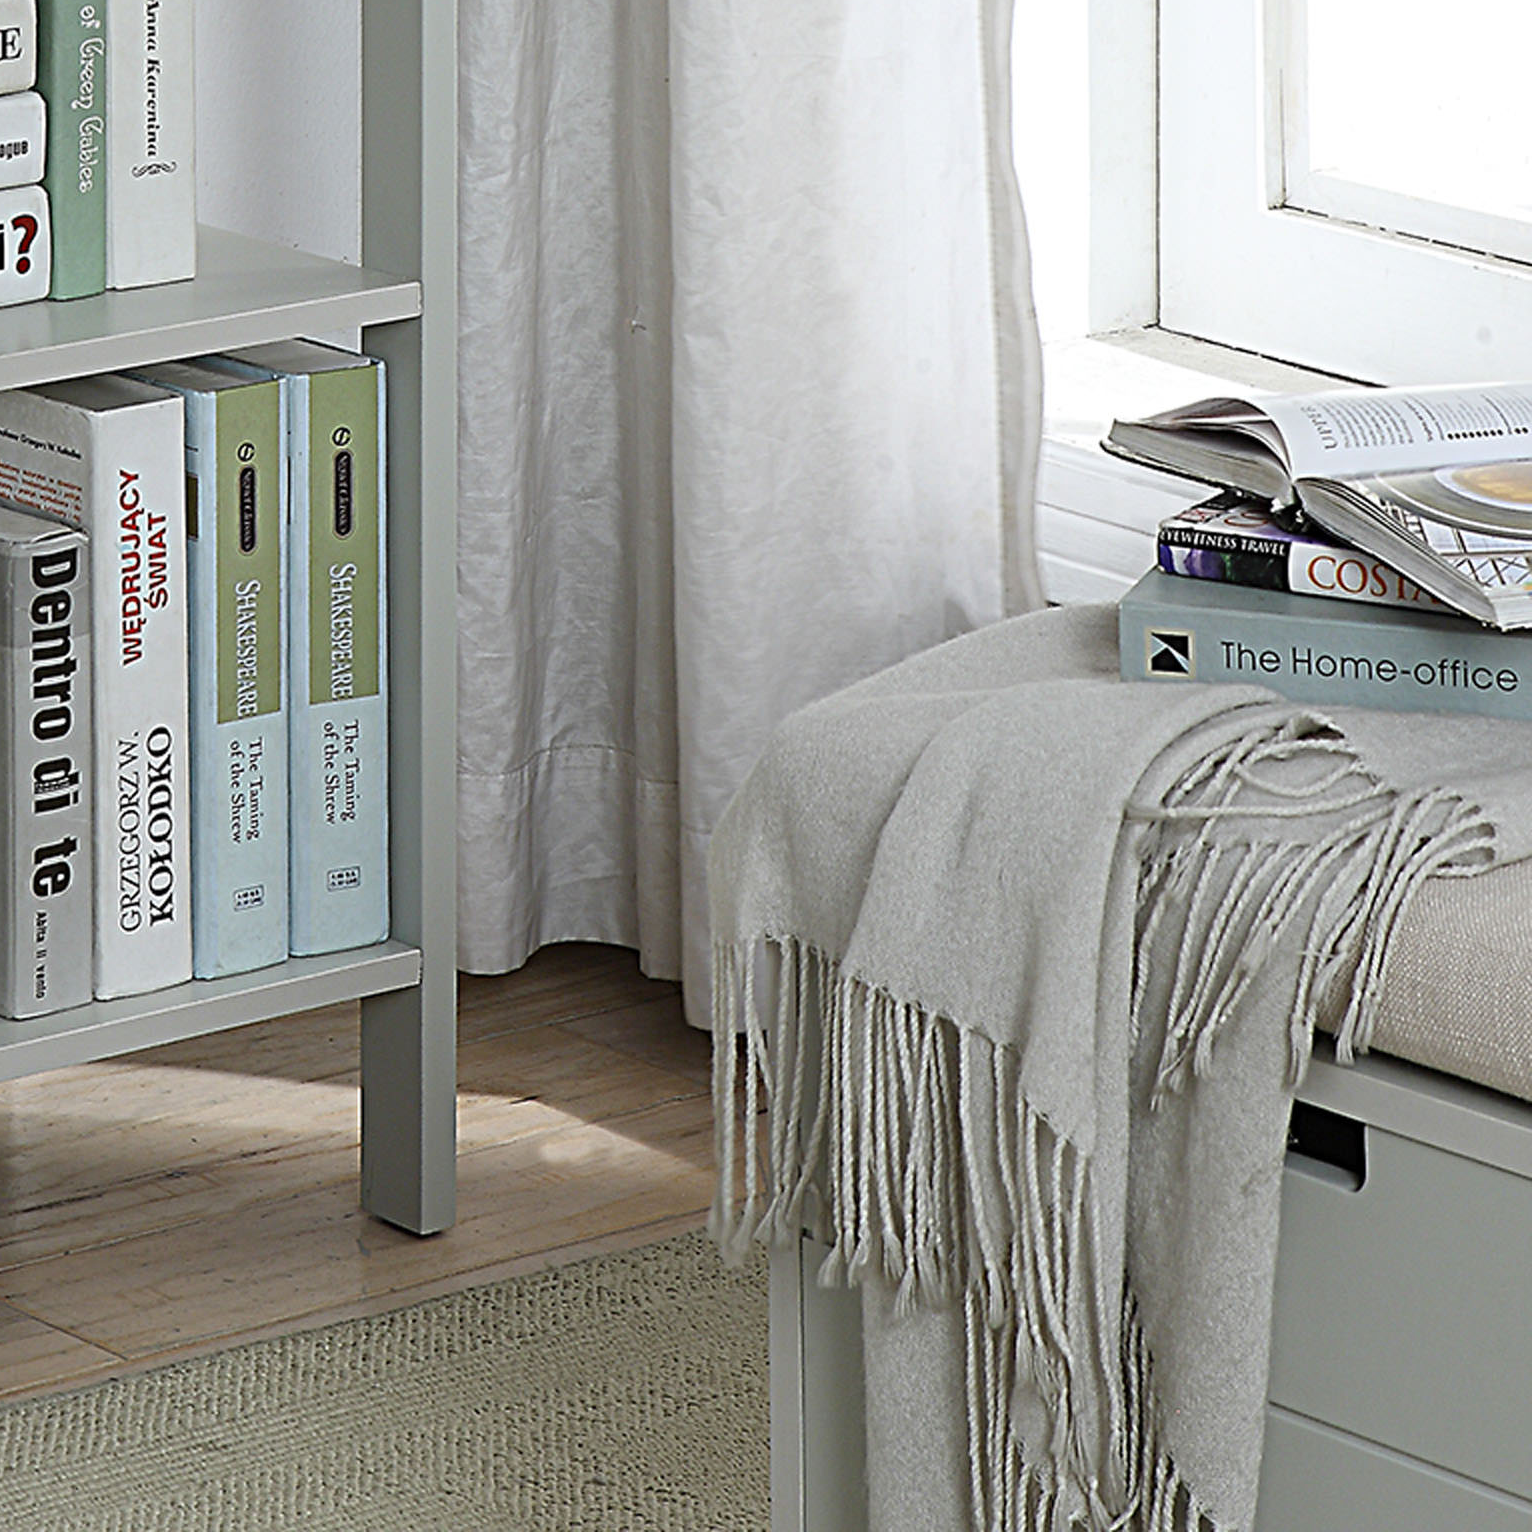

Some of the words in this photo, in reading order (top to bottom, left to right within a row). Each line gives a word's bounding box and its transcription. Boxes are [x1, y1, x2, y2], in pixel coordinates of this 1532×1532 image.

[79, 5, 101, 29] of
[70, 37, 105, 110] Green
[146, 58, 161, 157] Karenina
[78, 116, 105, 194] Gables
[119, 469, 147, 666] WĘDRUJĄCY
[144, 512, 169, 609] ŚWIAT
[1159, 529, 1237, 550] EYEWITNESS
[1240, 537, 1286, 557] TRAVEL
[31, 547, 78, 742] Dentro
[235, 579, 261, 718] SHAKESPEARE
[329, 562, 357, 700] SHAKESPEARE
[1220, 641, 1281, 673] The
[1291, 646, 1519, 693] Home-office
[118, 730, 140, 769] W.
[230, 740, 245, 759] of
[249, 735, 263, 772] The
[323, 722, 339, 740] of
[323, 743, 339, 770] the
[344, 719, 359, 754] The
[32, 758, 80, 814] di
[230, 762, 245, 789] the
[324, 774, 340, 825] Shrew
[340, 757, 361, 822] Taming
[146, 726, 175, 927] KOŁODKO
[231, 793, 246, 845] Shrew
[246, 776, 265, 842] Taming
[32, 835, 79, 898] te
[118, 771, 142, 932] GRZEGORZ
